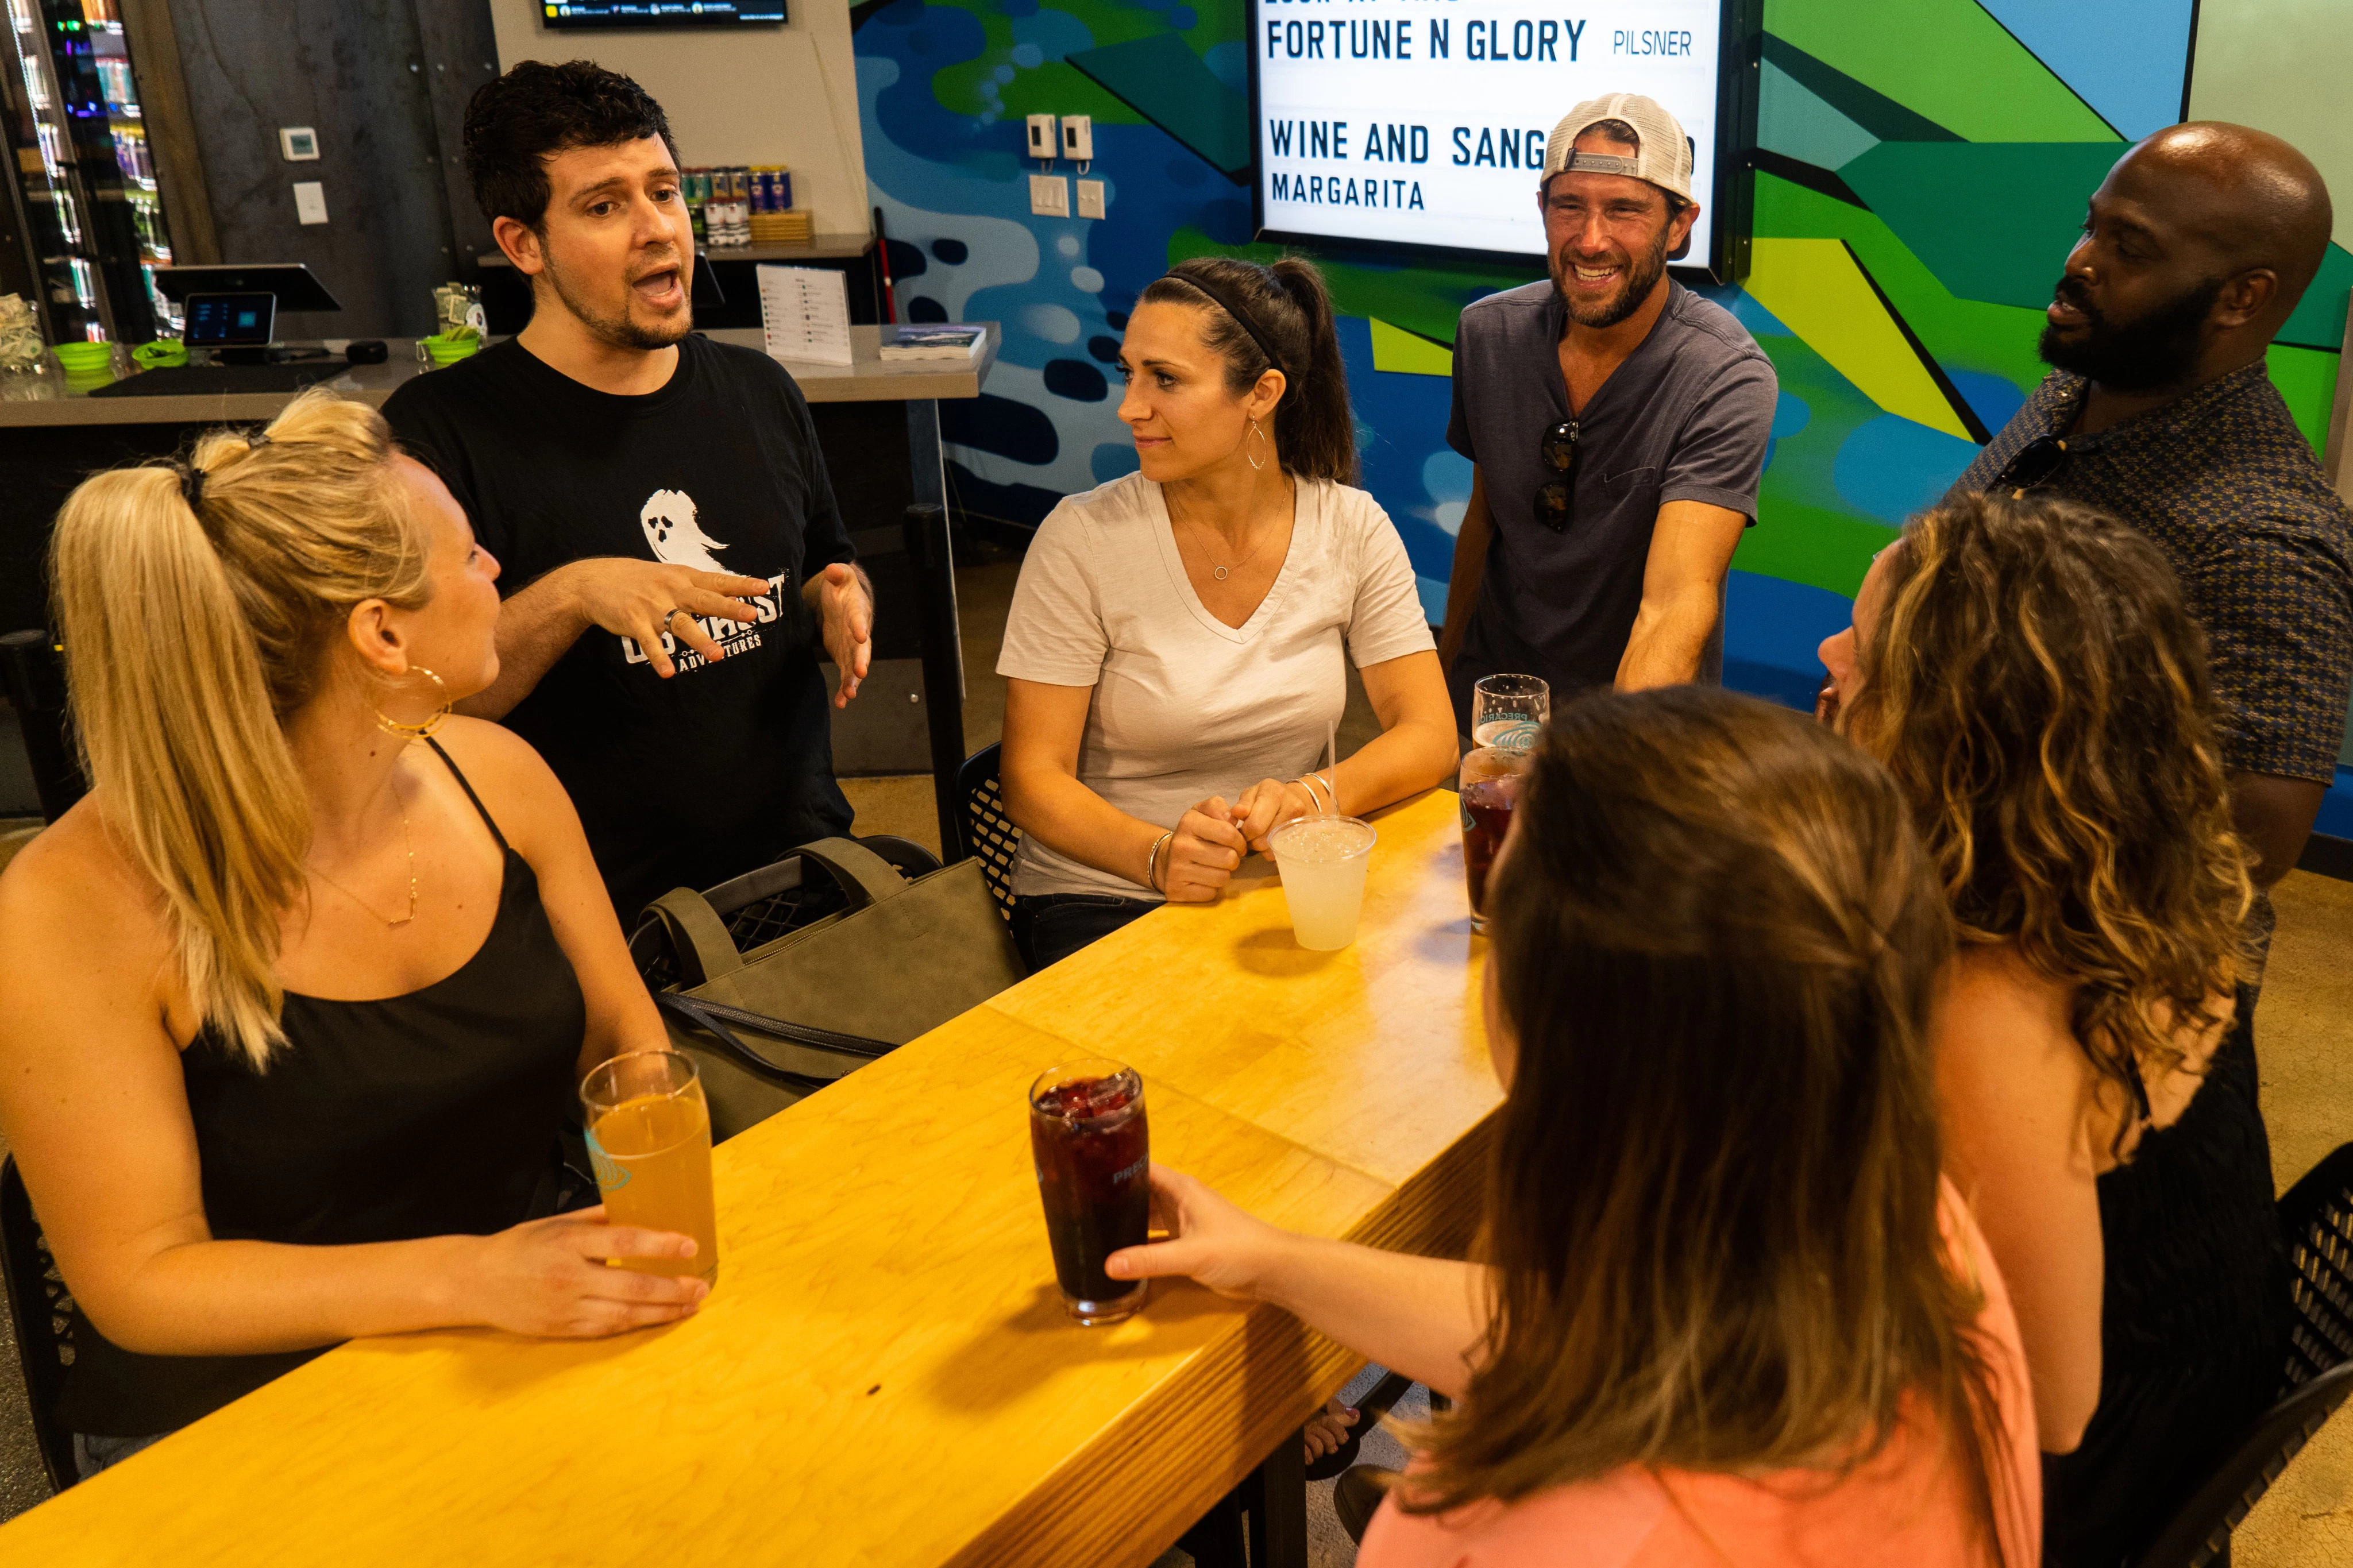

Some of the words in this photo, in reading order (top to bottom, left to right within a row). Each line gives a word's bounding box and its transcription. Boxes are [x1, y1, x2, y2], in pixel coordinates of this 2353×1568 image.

[1267, 20, 1411, 59] FORTUNE
[1430, 18, 1449, 59] N
[1467, 20, 1587, 61] GLORY
[1613, 30, 1692, 56] PILSNER
[1270, 119, 1348, 159] WINE
[1364, 123, 1429, 164] AND
[1452, 126, 1546, 169] SANG
[1272, 173, 1425, 211] MARGARITA
[679, 634, 762, 672] ADVTURES
